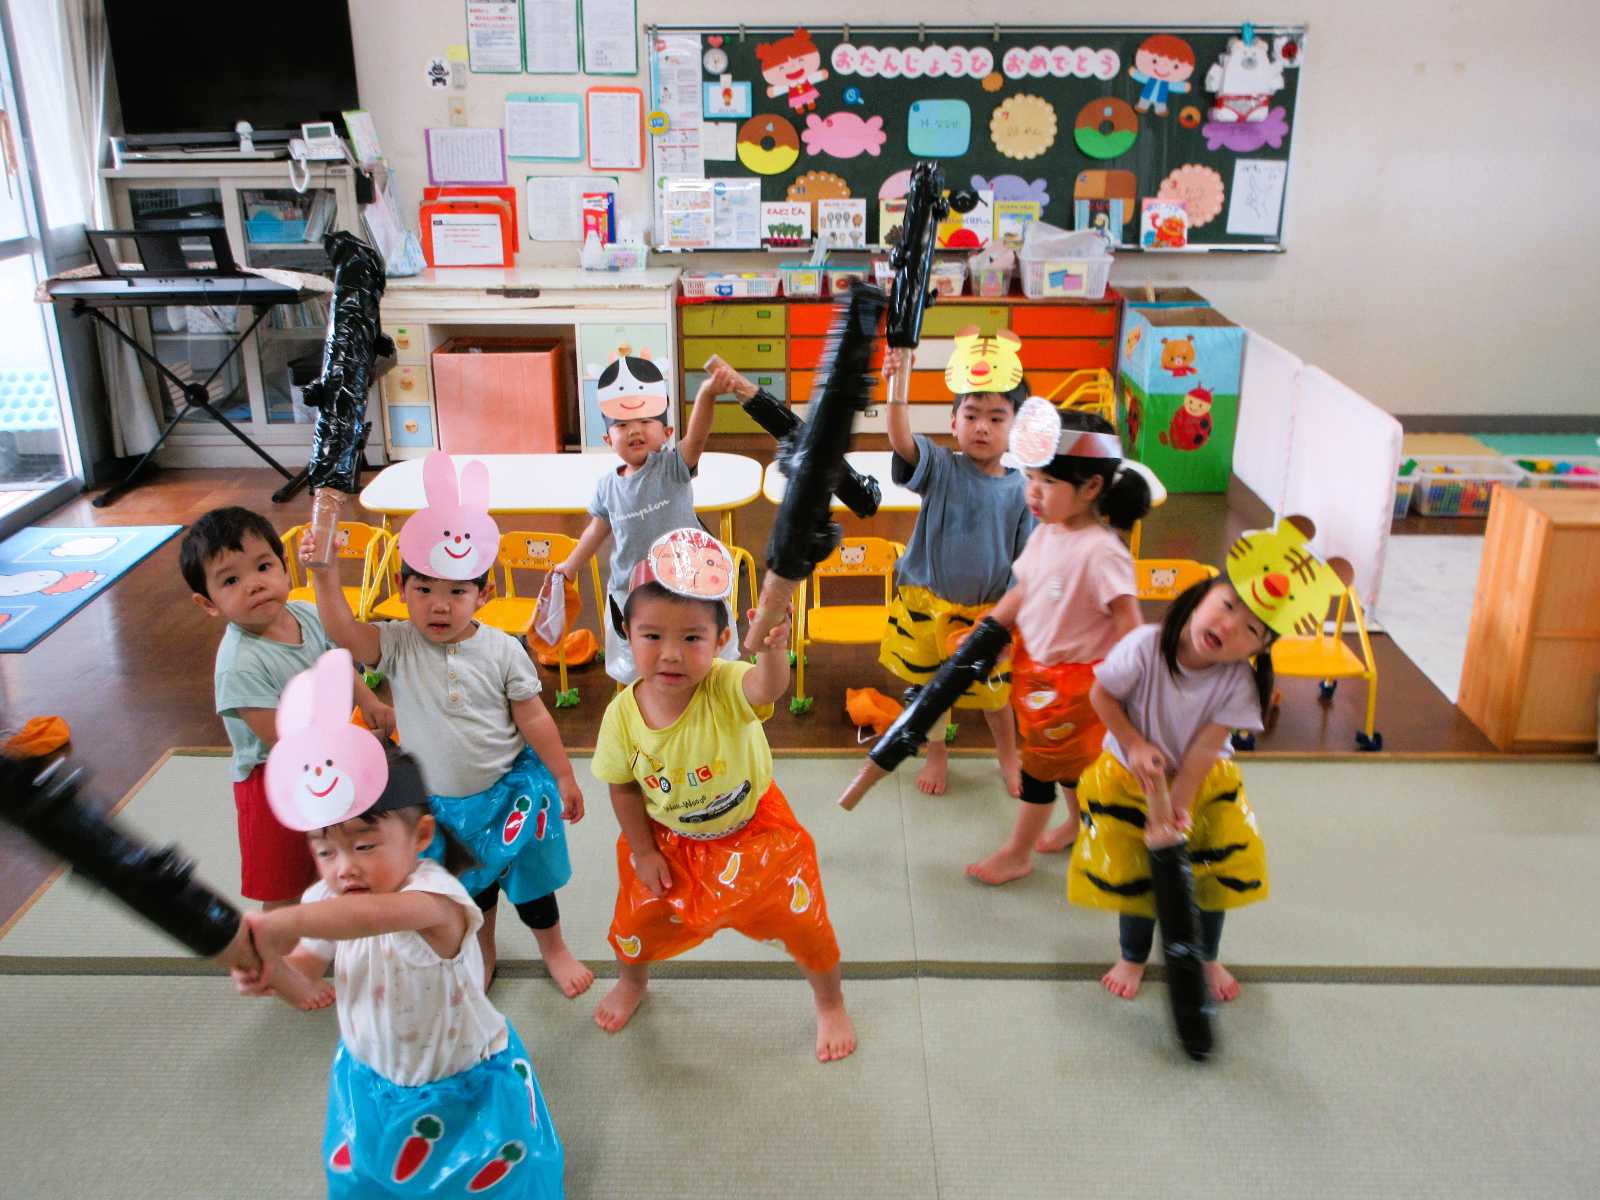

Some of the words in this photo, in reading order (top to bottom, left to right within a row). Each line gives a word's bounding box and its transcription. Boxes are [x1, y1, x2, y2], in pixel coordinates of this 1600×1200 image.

[1005, 53, 1114, 76] おめでとう
